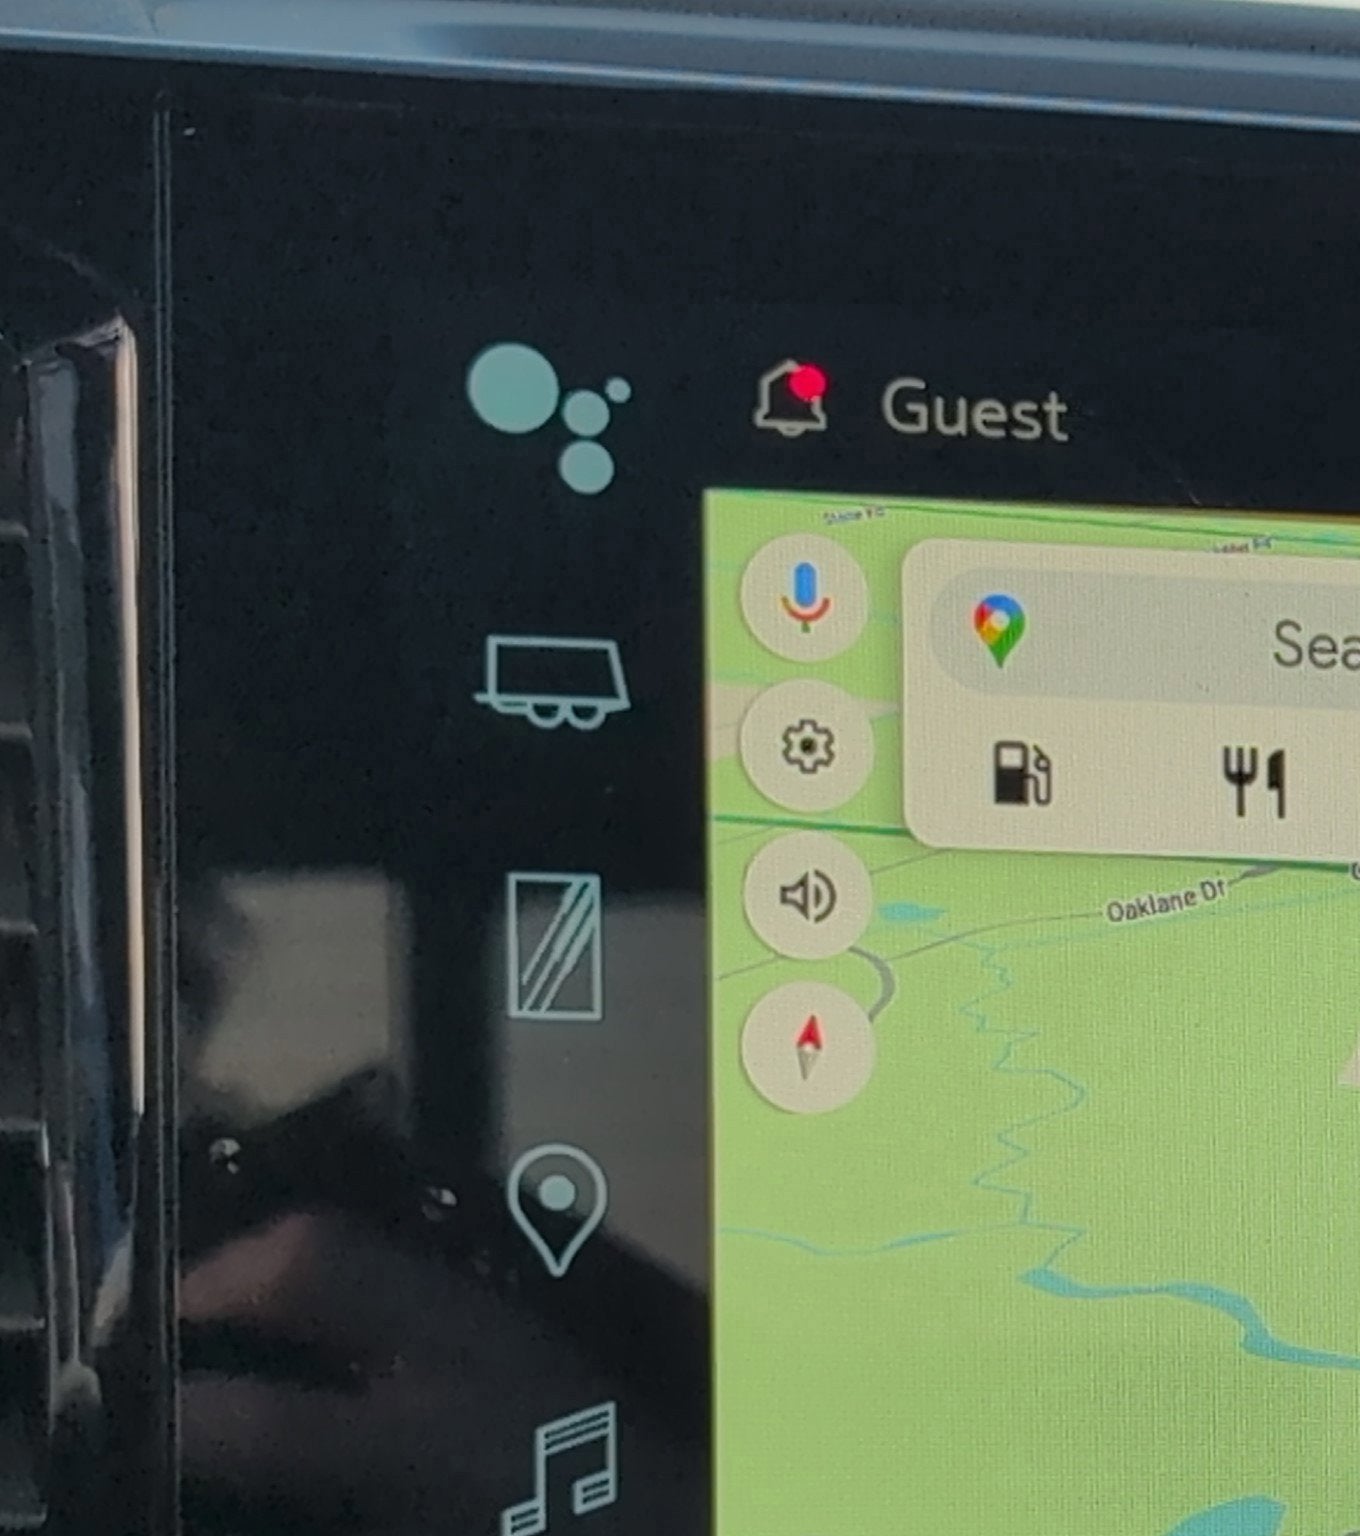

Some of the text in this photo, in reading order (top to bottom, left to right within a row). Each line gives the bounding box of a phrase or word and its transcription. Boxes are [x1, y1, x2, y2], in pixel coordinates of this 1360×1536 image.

[882, 376, 1069, 441] Guest
[1107, 878, 1228, 923] Oaklane Dr
